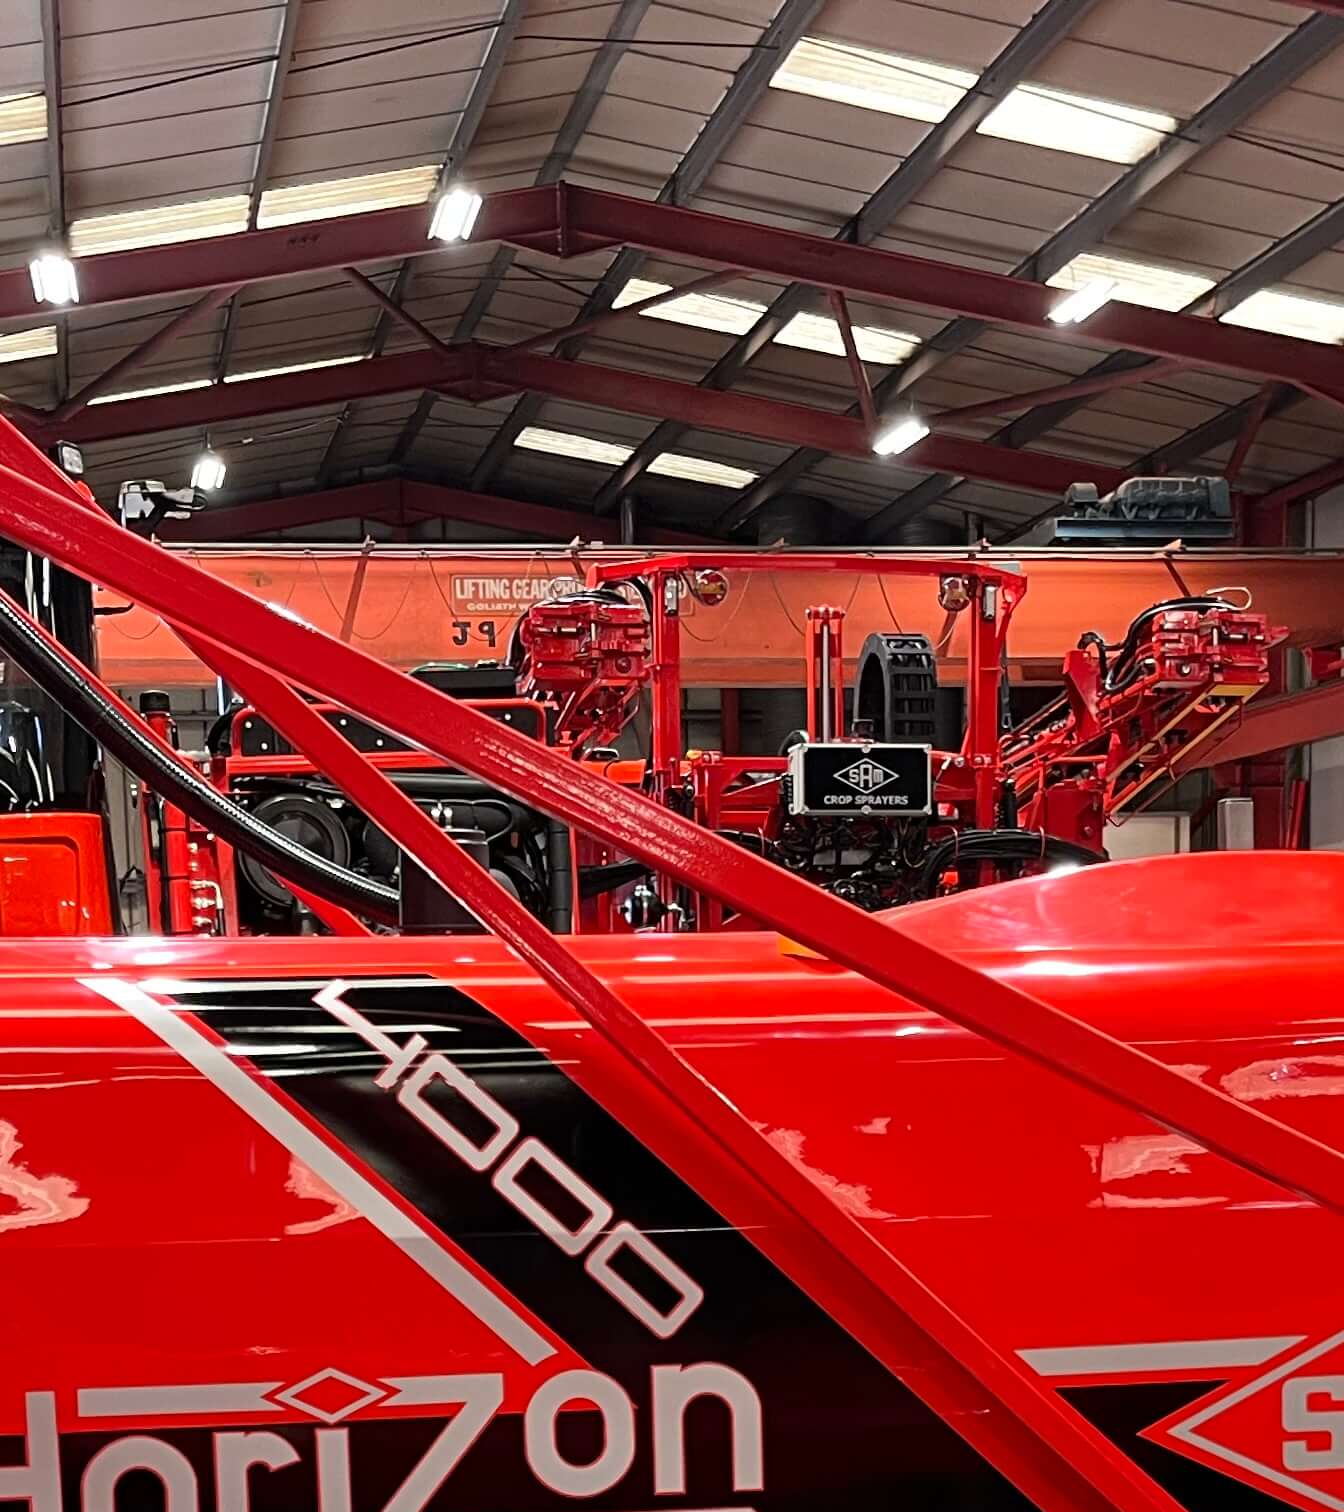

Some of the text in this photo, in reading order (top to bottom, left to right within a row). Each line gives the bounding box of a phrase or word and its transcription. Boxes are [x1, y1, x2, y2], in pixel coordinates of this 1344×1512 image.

[455, 578, 510, 600] LIFTING
[512, 578, 549, 600] GEAR
[466, 602, 519, 612] GOLIATH
[823, 795, 909, 805] CROP SPRAYERS
[313, 979, 703, 1339] 4000
